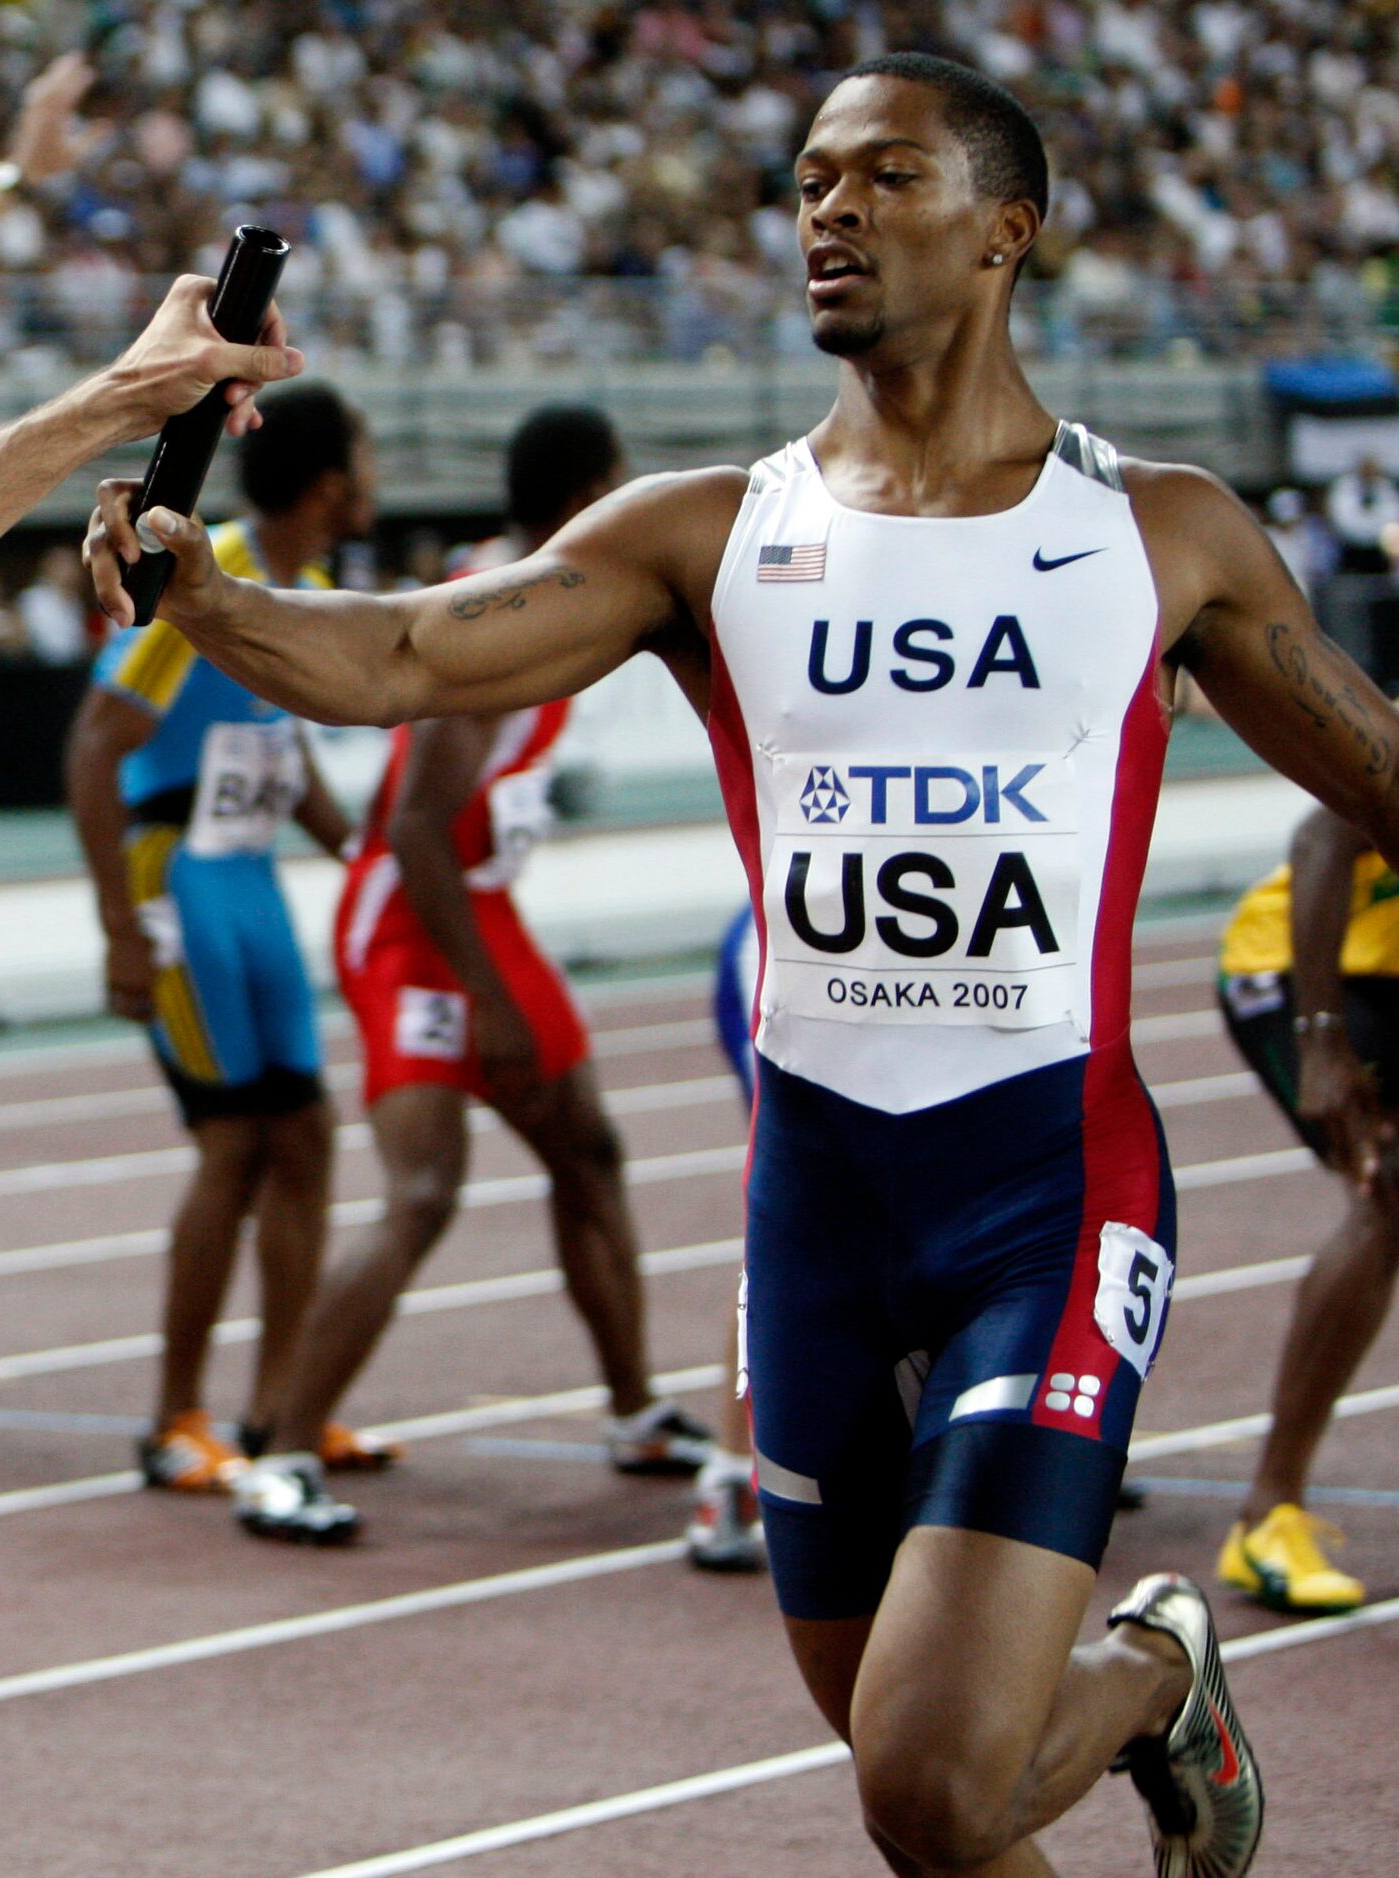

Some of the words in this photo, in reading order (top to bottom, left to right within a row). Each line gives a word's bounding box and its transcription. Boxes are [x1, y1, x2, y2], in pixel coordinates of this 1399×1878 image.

[807, 615, 1042, 695] USA
[847, 763, 1050, 824] TDK
[784, 851, 1060, 958] USA
[826, 976, 941, 1008] OSAKA
[952, 983, 1029, 1010] 2007
[1123, 1250, 1159, 1345] 5
